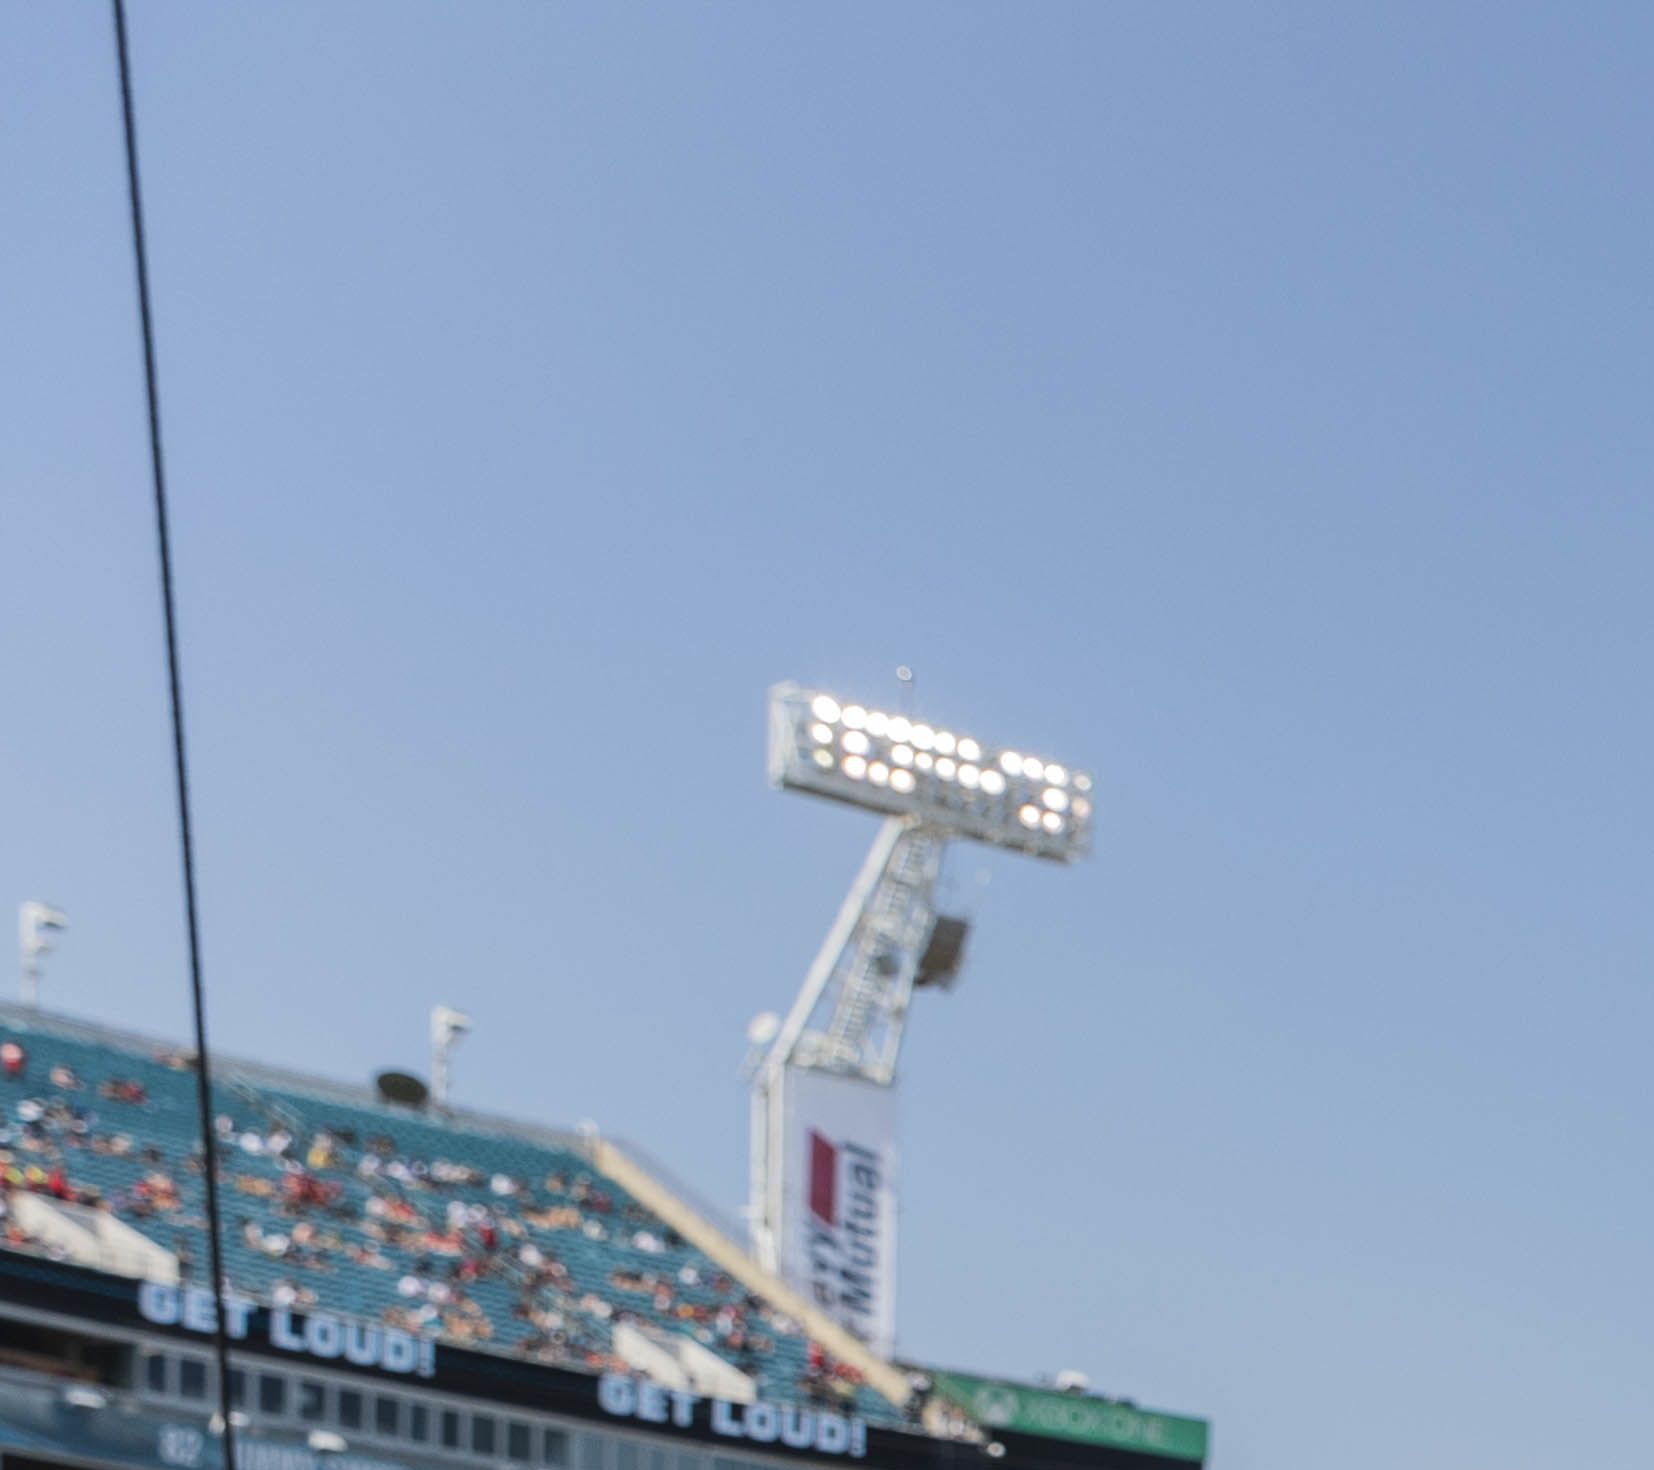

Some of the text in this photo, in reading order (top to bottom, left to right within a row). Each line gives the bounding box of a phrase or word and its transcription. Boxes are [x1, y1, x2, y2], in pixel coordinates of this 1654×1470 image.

[837, 1141, 880, 1316] Mutual
[138, 1282, 436, 1378] GET LOUD!
[598, 1372, 867, 1458] GET LOUD!
